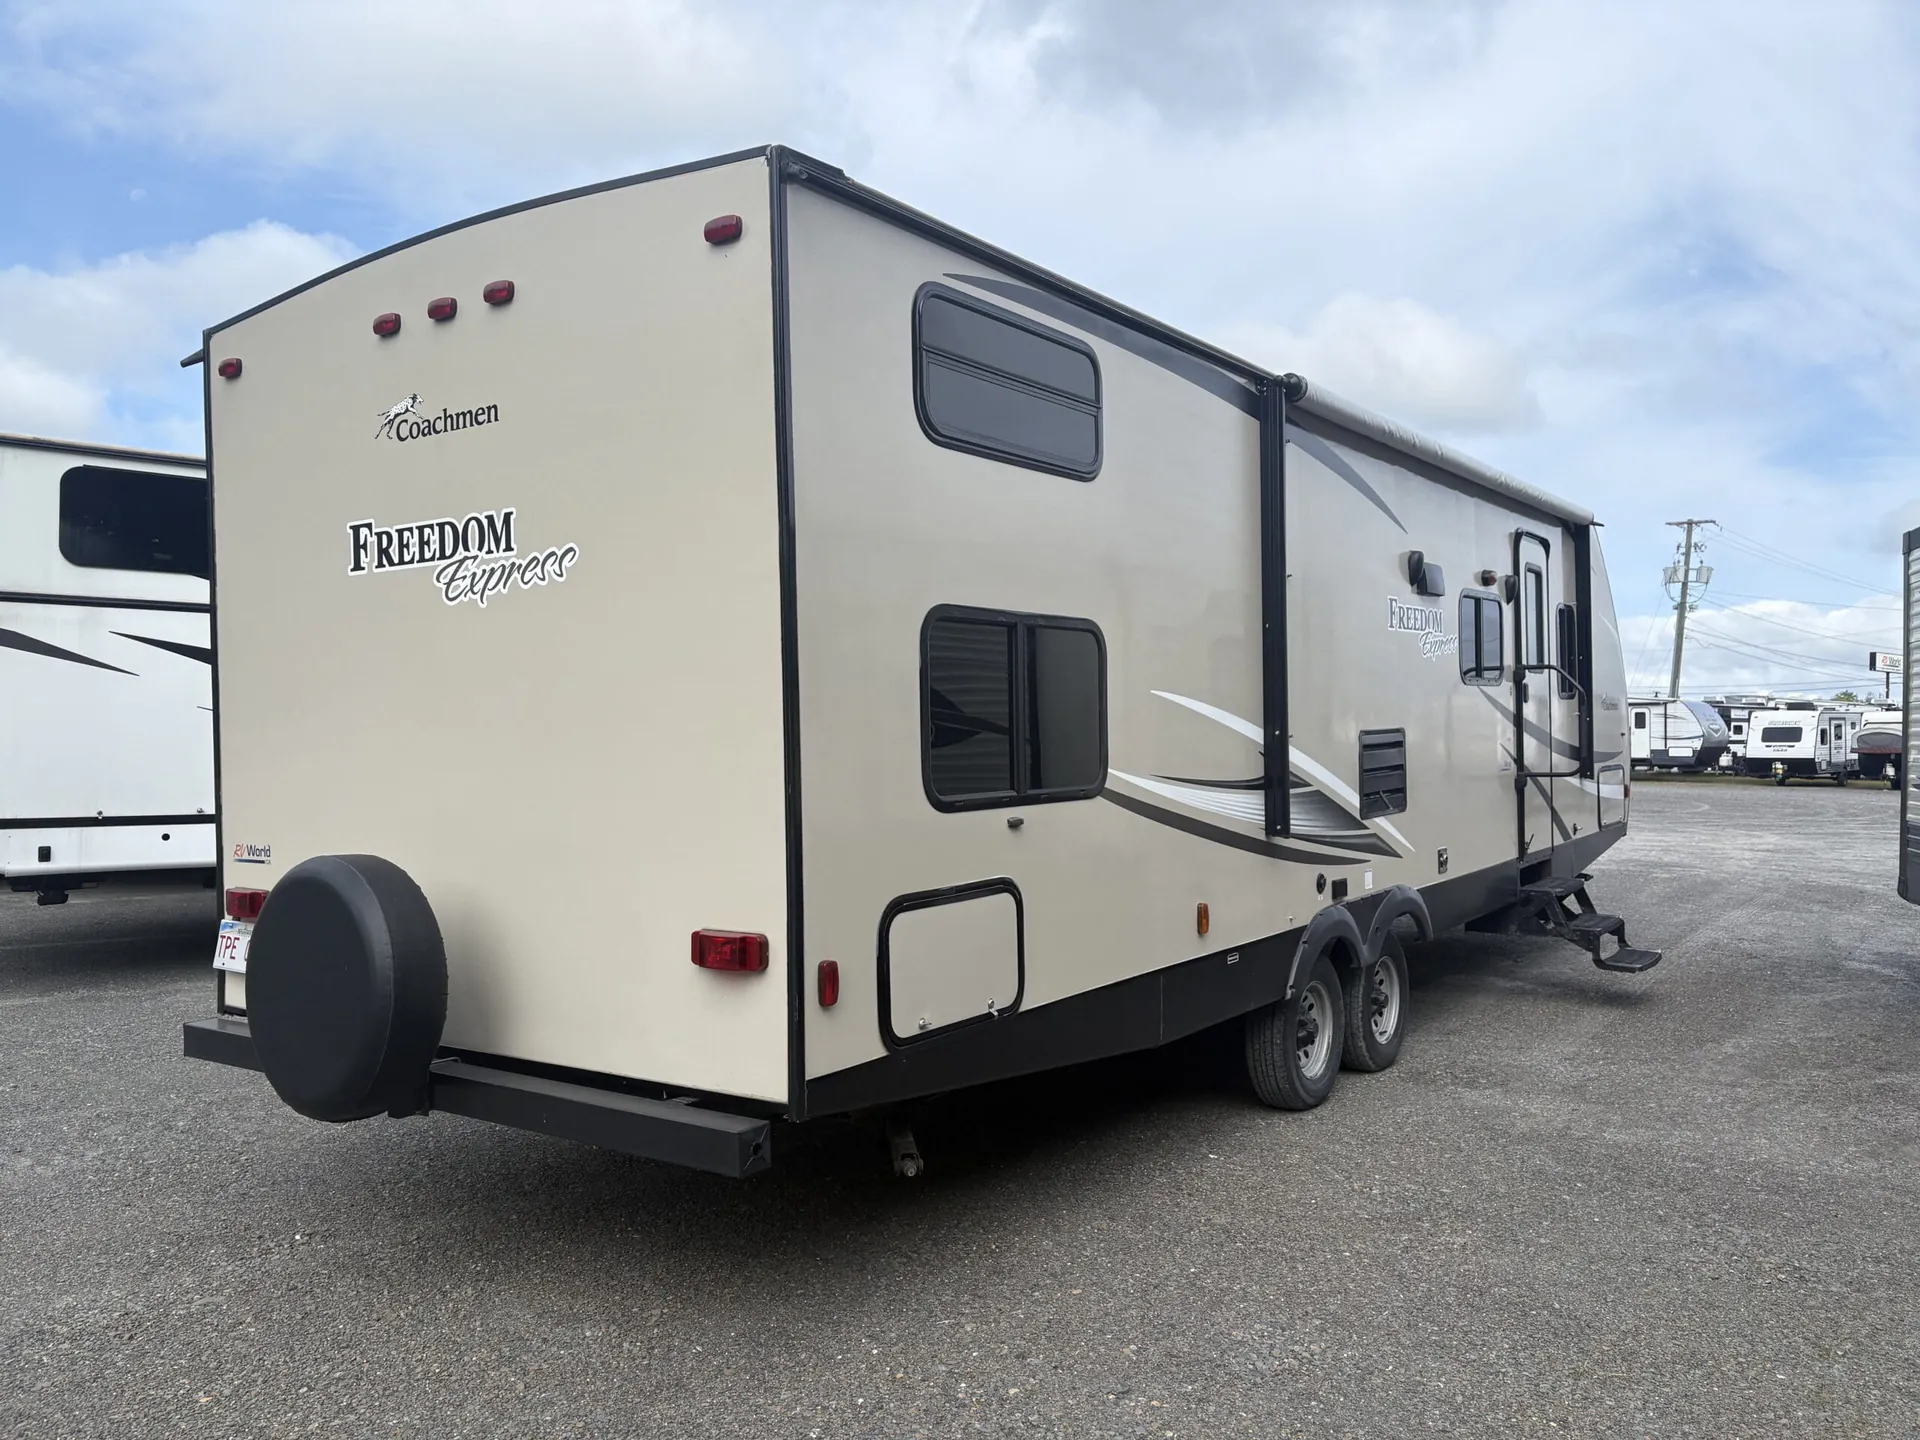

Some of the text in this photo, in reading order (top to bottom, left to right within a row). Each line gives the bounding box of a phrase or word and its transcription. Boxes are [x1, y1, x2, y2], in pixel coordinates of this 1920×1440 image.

[396, 403, 500, 442] Coachmen
[348, 509, 516, 573] FREEDOM
[435, 544, 578, 606] Express
[1388, 597, 1443, 634] FREEDOM
[1420, 631, 1458, 660] Express
[233, 843, 272, 858] RV World
[218, 934, 240, 960] TPE
